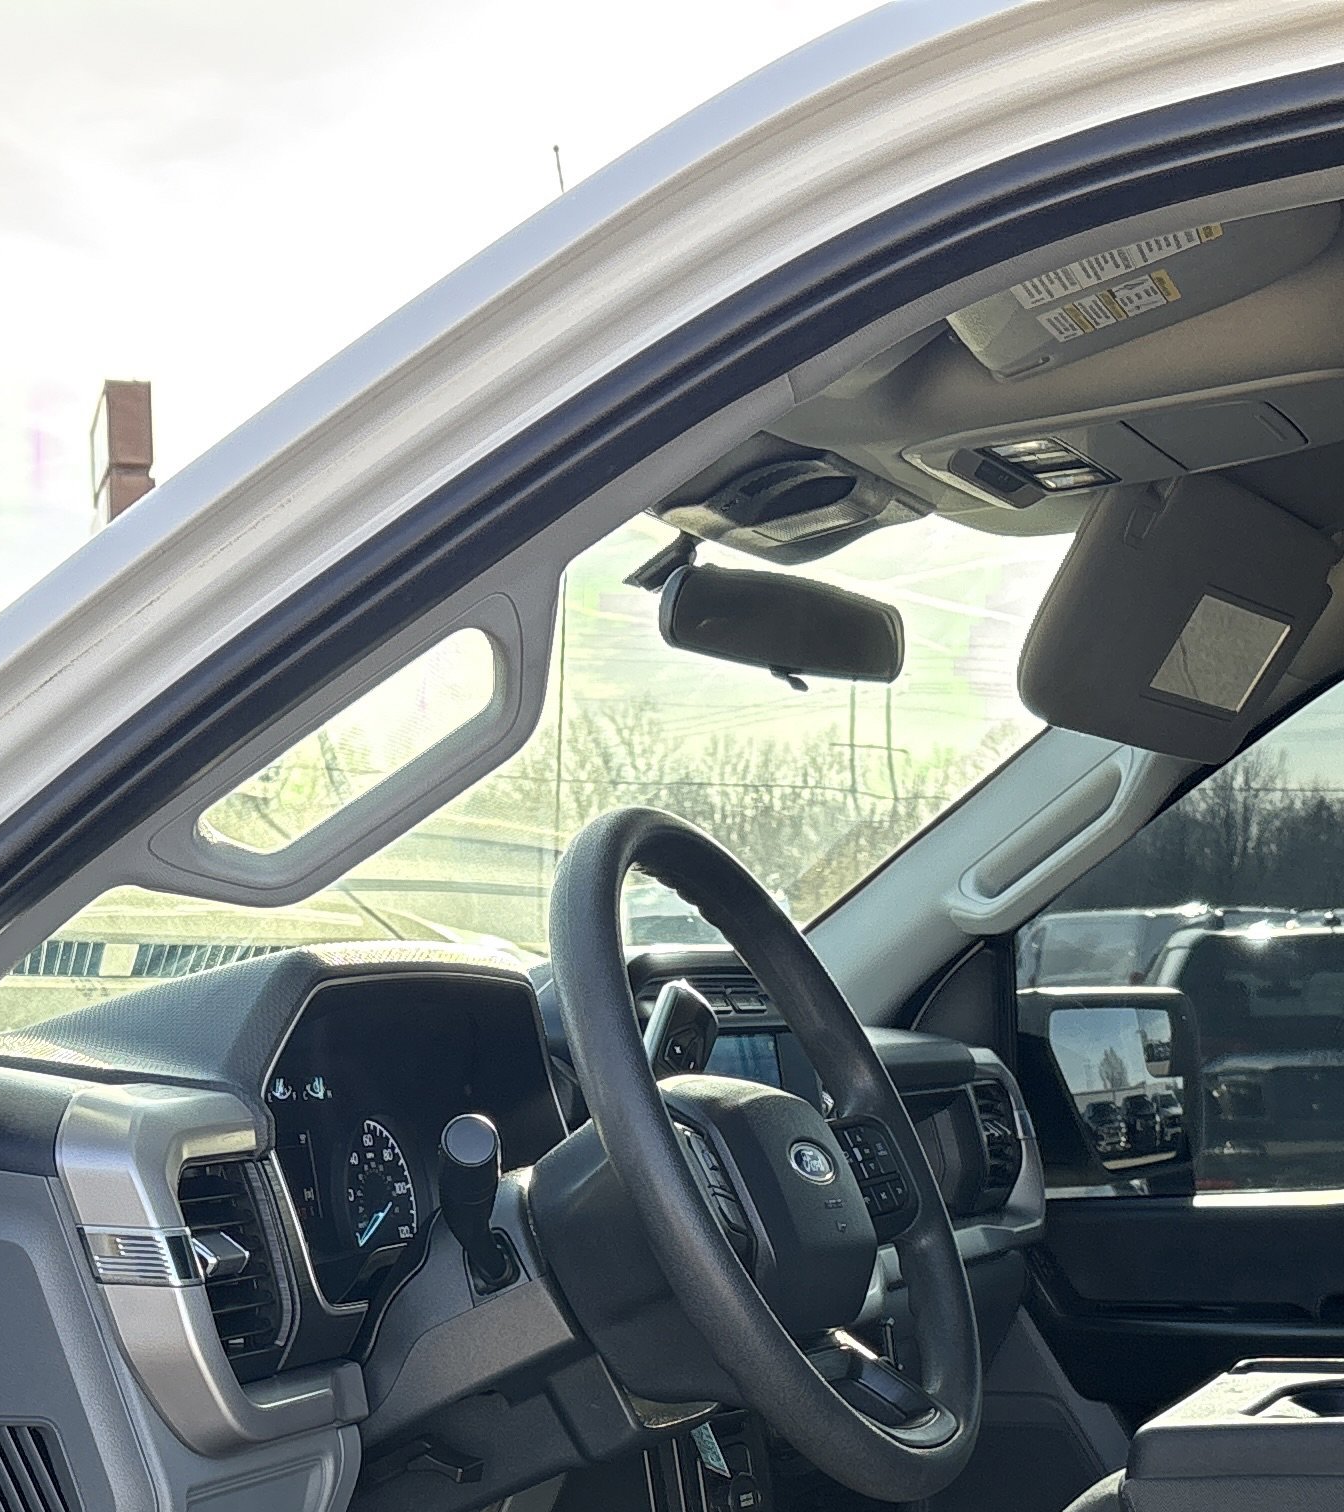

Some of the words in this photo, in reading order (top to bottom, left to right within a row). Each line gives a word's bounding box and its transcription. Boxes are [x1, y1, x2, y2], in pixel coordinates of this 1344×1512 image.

[362, 1133, 373, 1147] 60
[382, 1148, 393, 1161] 80
[394, 1181, 407, 1195] 100
